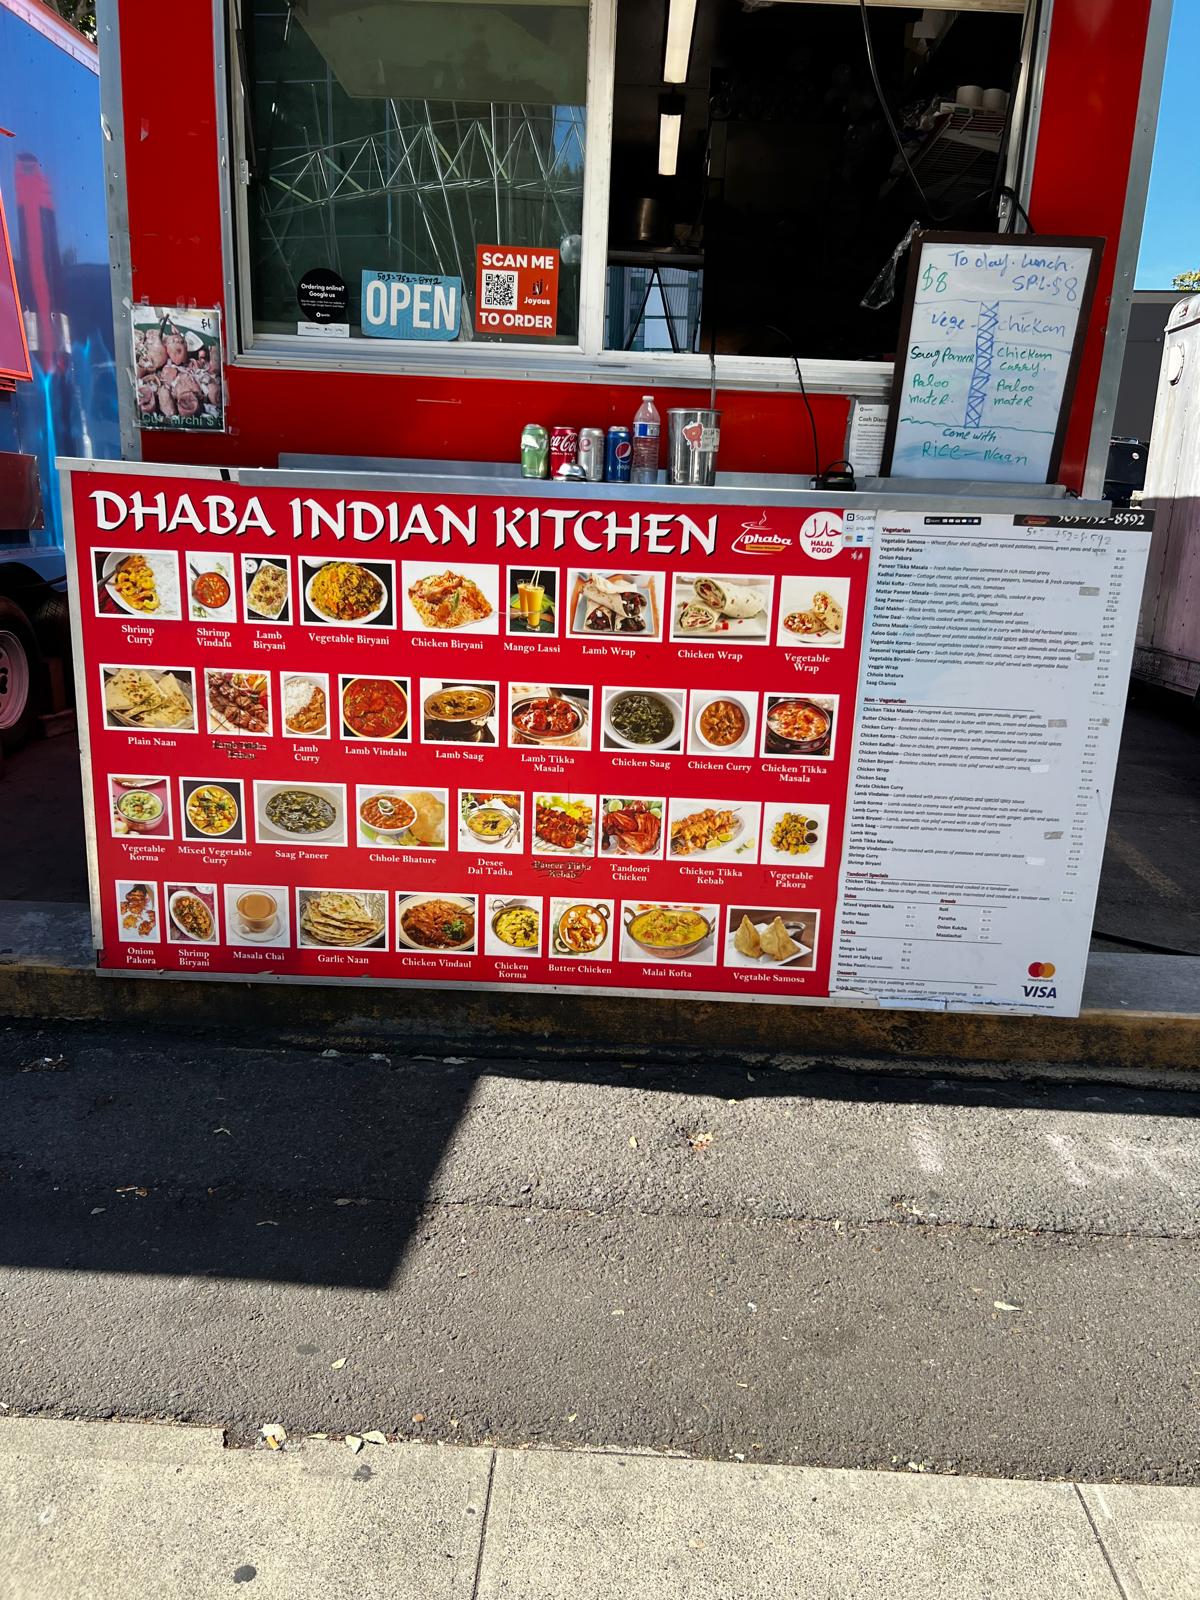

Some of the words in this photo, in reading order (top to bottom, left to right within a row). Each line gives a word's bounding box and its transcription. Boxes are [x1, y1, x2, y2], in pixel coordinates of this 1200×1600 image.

[482, 253, 528, 268] SCAN
[531, 256, 554, 269] ME
[948, 252, 968, 266] To
[921, 264, 948, 292] $8
[301, 284, 327, 292] Ordering
[309, 291, 327, 299] Google
[366, 280, 456, 331] OPEN
[524, 297, 550, 305] Joyous
[480, 312, 497, 325] TO
[499, 313, 552, 328] ORDER
[89, 490, 276, 536] DHABA
[289, 497, 478, 547] INDIAN
[491, 506, 718, 557] KITCHEN
[741, 534, 793, 546] Dhaba
[122, 625, 154, 637] Shrimp
[197, 628, 230, 639] Shrimp
[257, 631, 282, 639] Lamb
[127, 635, 153, 645] Curry
[197, 637, 232, 647] Vindalu
[309, 633, 354, 644] Vegetable
[357, 635, 389, 644] Biryani
[254, 641, 285, 649] Biryani
[412, 638, 448, 647] Chicken
[451, 640, 483, 651] Biryani
[504, 643, 534, 653] Mango
[538, 644, 560, 652] Lassi
[583, 646, 607, 654] Lamb
[611, 647, 635, 658] Wrap
[678, 650, 714, 658] Chicken
[718, 651, 742, 662] Wrap
[785, 653, 830, 664] Vegetable
[794, 663, 819, 674] Wrap
[128, 737, 150, 745] Plain
[154, 738, 176, 746] Naan
[294, 744, 318, 752] Lamb
[346, 746, 370, 754] Lamb
[373, 748, 407, 756] Vindalu
[295, 754, 319, 764] Curry
[463, 752, 483, 762] Saag
[522, 754, 545, 762] Lamb
[535, 764, 564, 772] Masala
[612, 758, 647, 766] Chicken
[650, 760, 670, 769] Saag
[688, 761, 723, 769] Chicken
[726, 763, 751, 773] Curry
[762, 764, 797, 772] Chicken
[780, 774, 810, 782] Masala
[122, 844, 165, 855] Vegetable
[178, 846, 205, 854] Mixed
[209, 848, 252, 858] Vegetable
[130, 852, 158, 861] Korma
[203, 855, 227, 865] Curry
[276, 851, 296, 860] Saag
[299, 851, 328, 859] Paneer
[370, 854, 400, 862] Chhole
[610, 864, 649, 872] Tandoori
[680, 867, 714, 875] Chicken
[613, 873, 646, 881] Chicken
[770, 871, 813, 881] Vegetable
[776, 880, 806, 888] Pakora
[179, 950, 209, 960] Shrimp
[318, 955, 344, 963] Garlic
[180, 957, 210, 967] Biryani
[402, 958, 436, 966] Chicken
[733, 973, 770, 982] Vegtable
[1021, 985, 1057, 998] VISA
